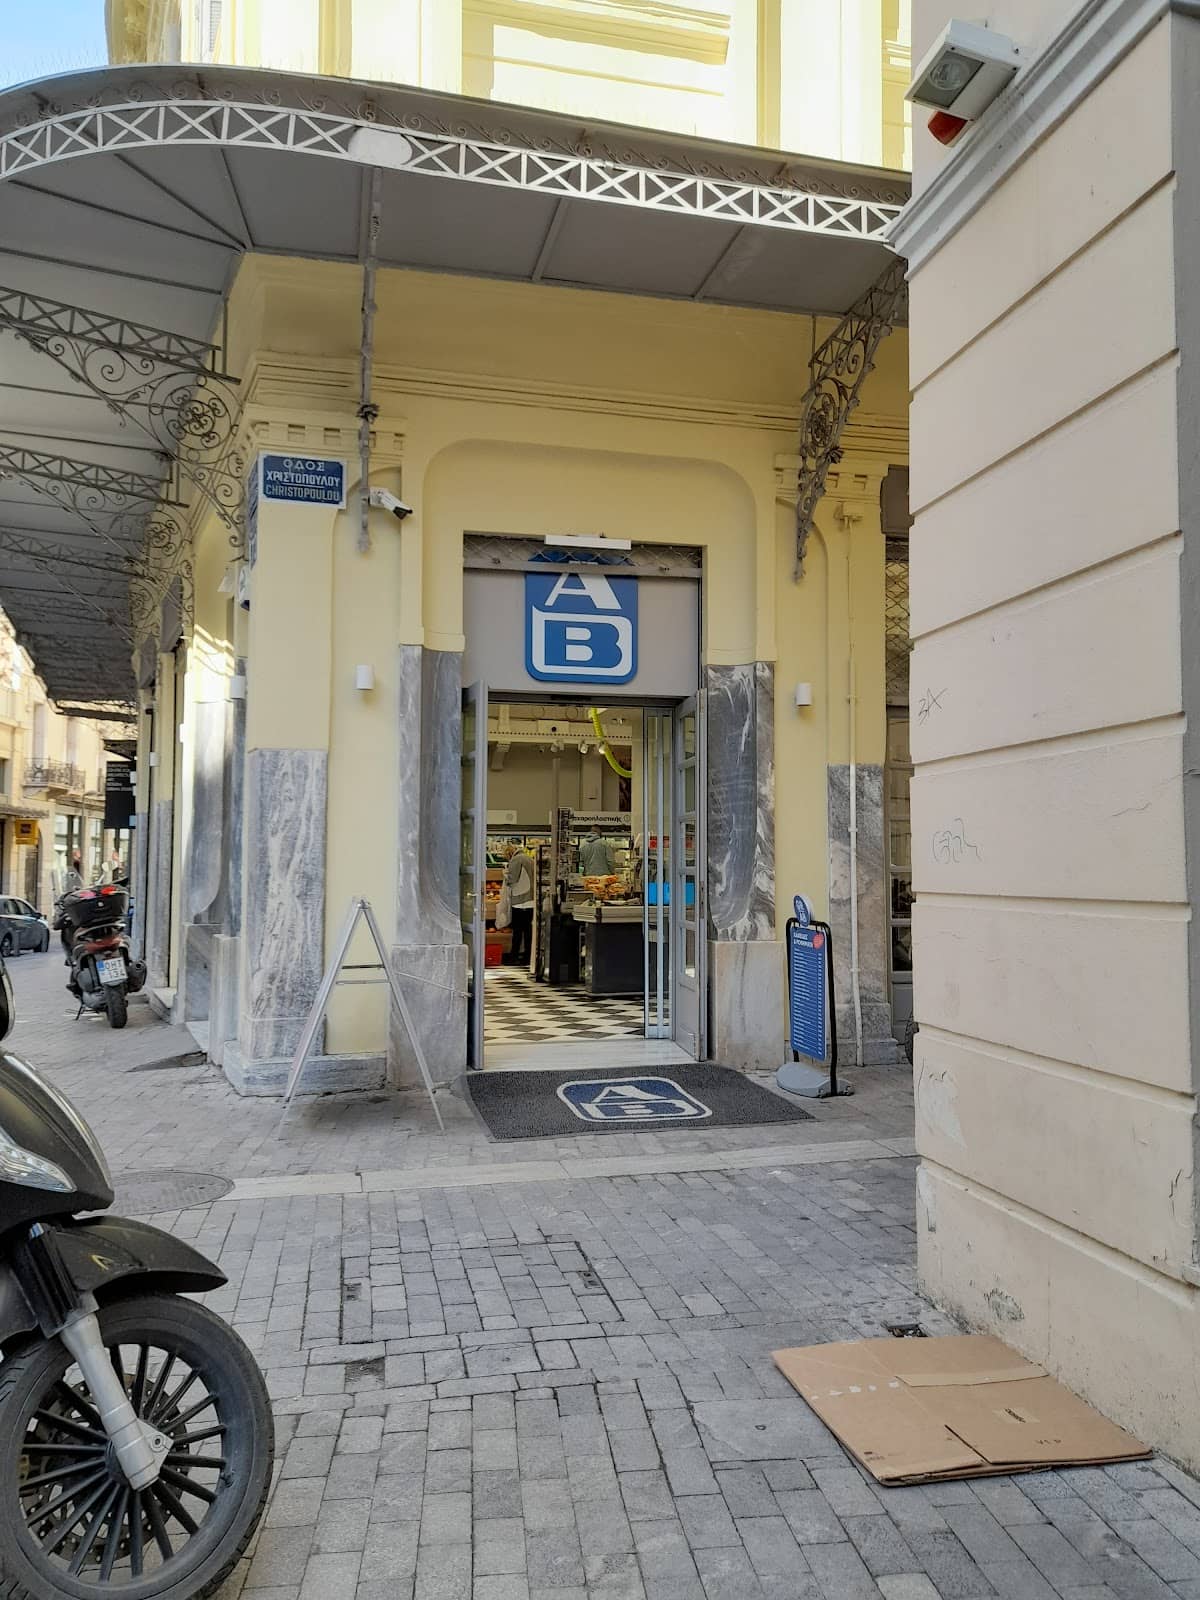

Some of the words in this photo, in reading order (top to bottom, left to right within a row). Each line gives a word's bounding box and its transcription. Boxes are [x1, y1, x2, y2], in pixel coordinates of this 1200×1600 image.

[283, 459, 325, 472] ΟΔΟΣ
[266, 470, 340, 488] ΧΡΙΣΤΟΠΟΥΛΟΥ
[265, 484, 340, 501] CHRISTOPOULOU
